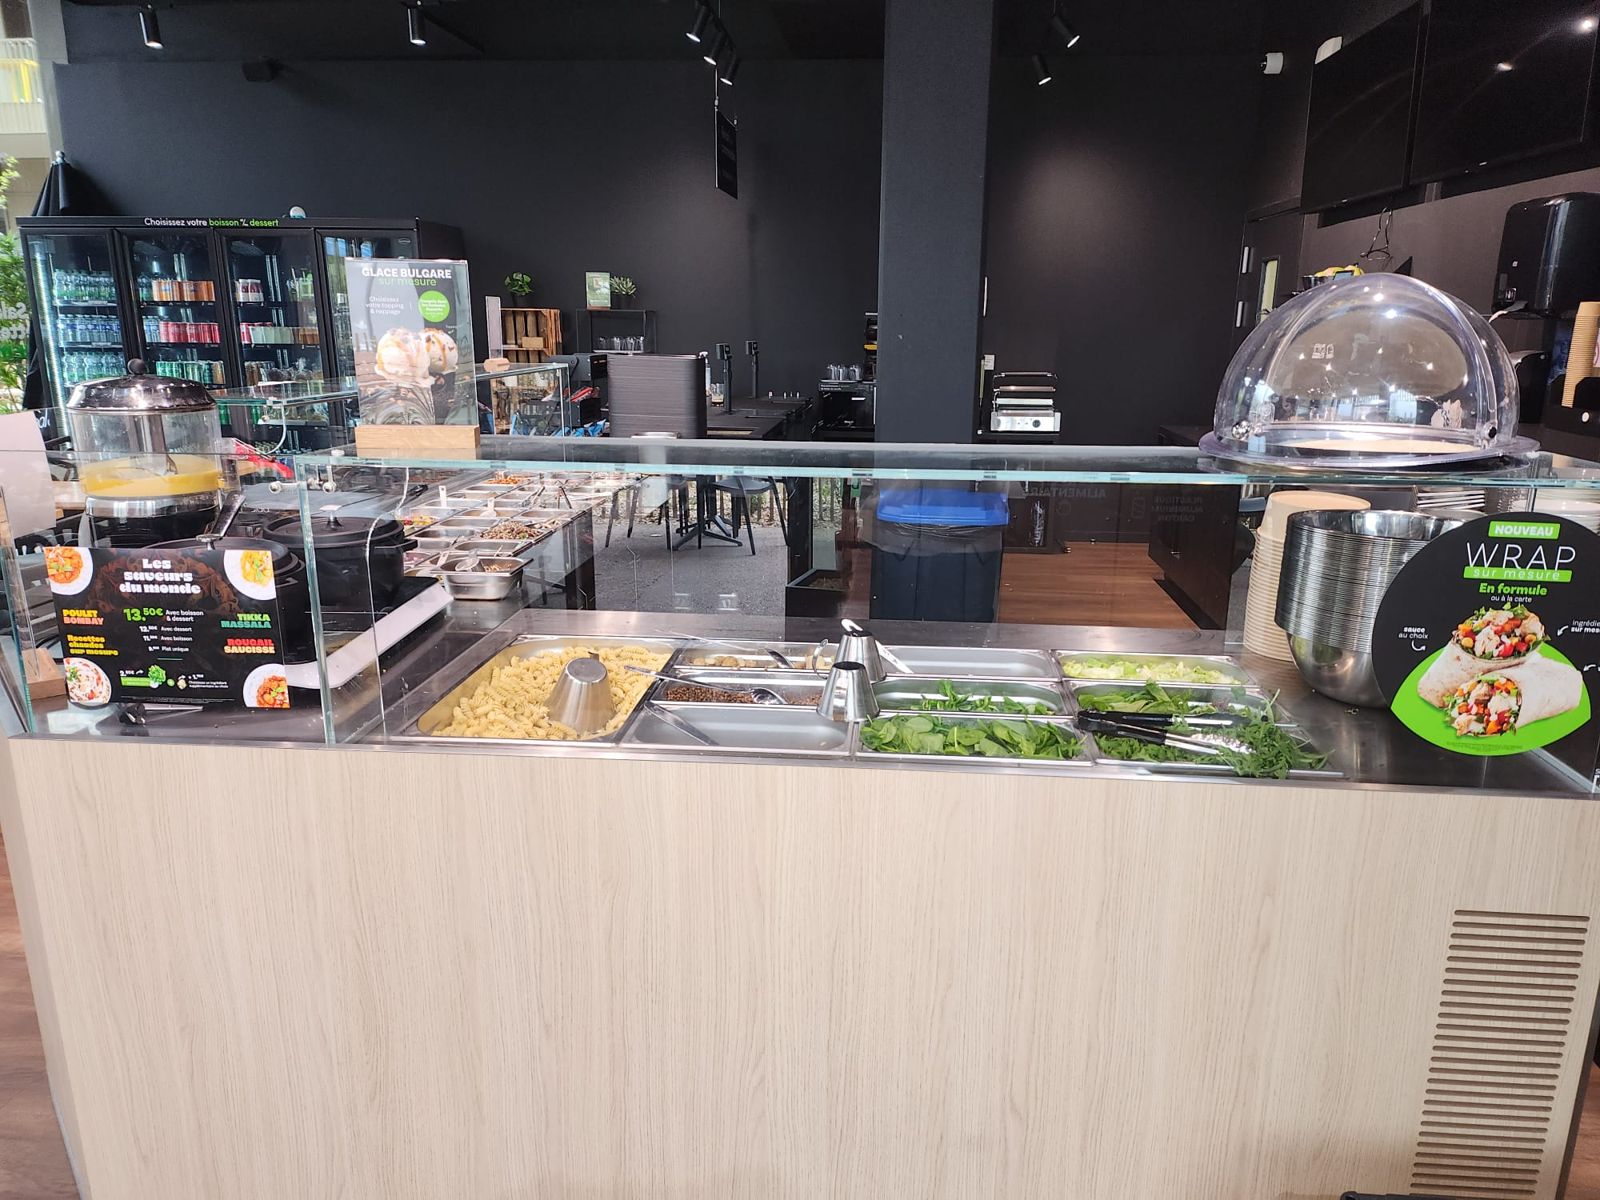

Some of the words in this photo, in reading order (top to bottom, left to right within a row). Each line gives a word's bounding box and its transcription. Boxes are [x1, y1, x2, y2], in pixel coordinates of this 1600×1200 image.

[144, 217, 185, 226] Choisissez
[187, 218, 208, 226] votre
[209, 218, 239, 227] boisson
[250, 218, 279, 227] dessert
[362, 268, 398, 278] GLACE
[401, 268, 452, 279] BULGARE
[378, 277, 393, 287] sur
[397, 278, 437, 287] mesure
[1494, 524, 1554, 537] NOUVEAU
[1466, 542, 1576, 571] WRAP
[142, 558, 172, 570] Les
[123, 571, 194, 582] saveurs
[1473, 568, 1497, 577] sur
[1504, 569, 1560, 580] mesure
[119, 582, 142, 593] du
[143, 583, 202, 594] monde
[1479, 582, 1494, 594] En
[1497, 582, 1548, 595] formule
[62, 609, 98, 618] POULET
[236, 613, 271, 621] TIKKA
[63, 616, 104, 625] BOMBAY
[220, 620, 272, 629] MASSALA
[67, 634, 106, 643] Recettes
[1411, 632, 1429, 640] choix
[226, 638, 273, 647] ROUGAIL
[223, 645, 276, 654] SAUCISSE
